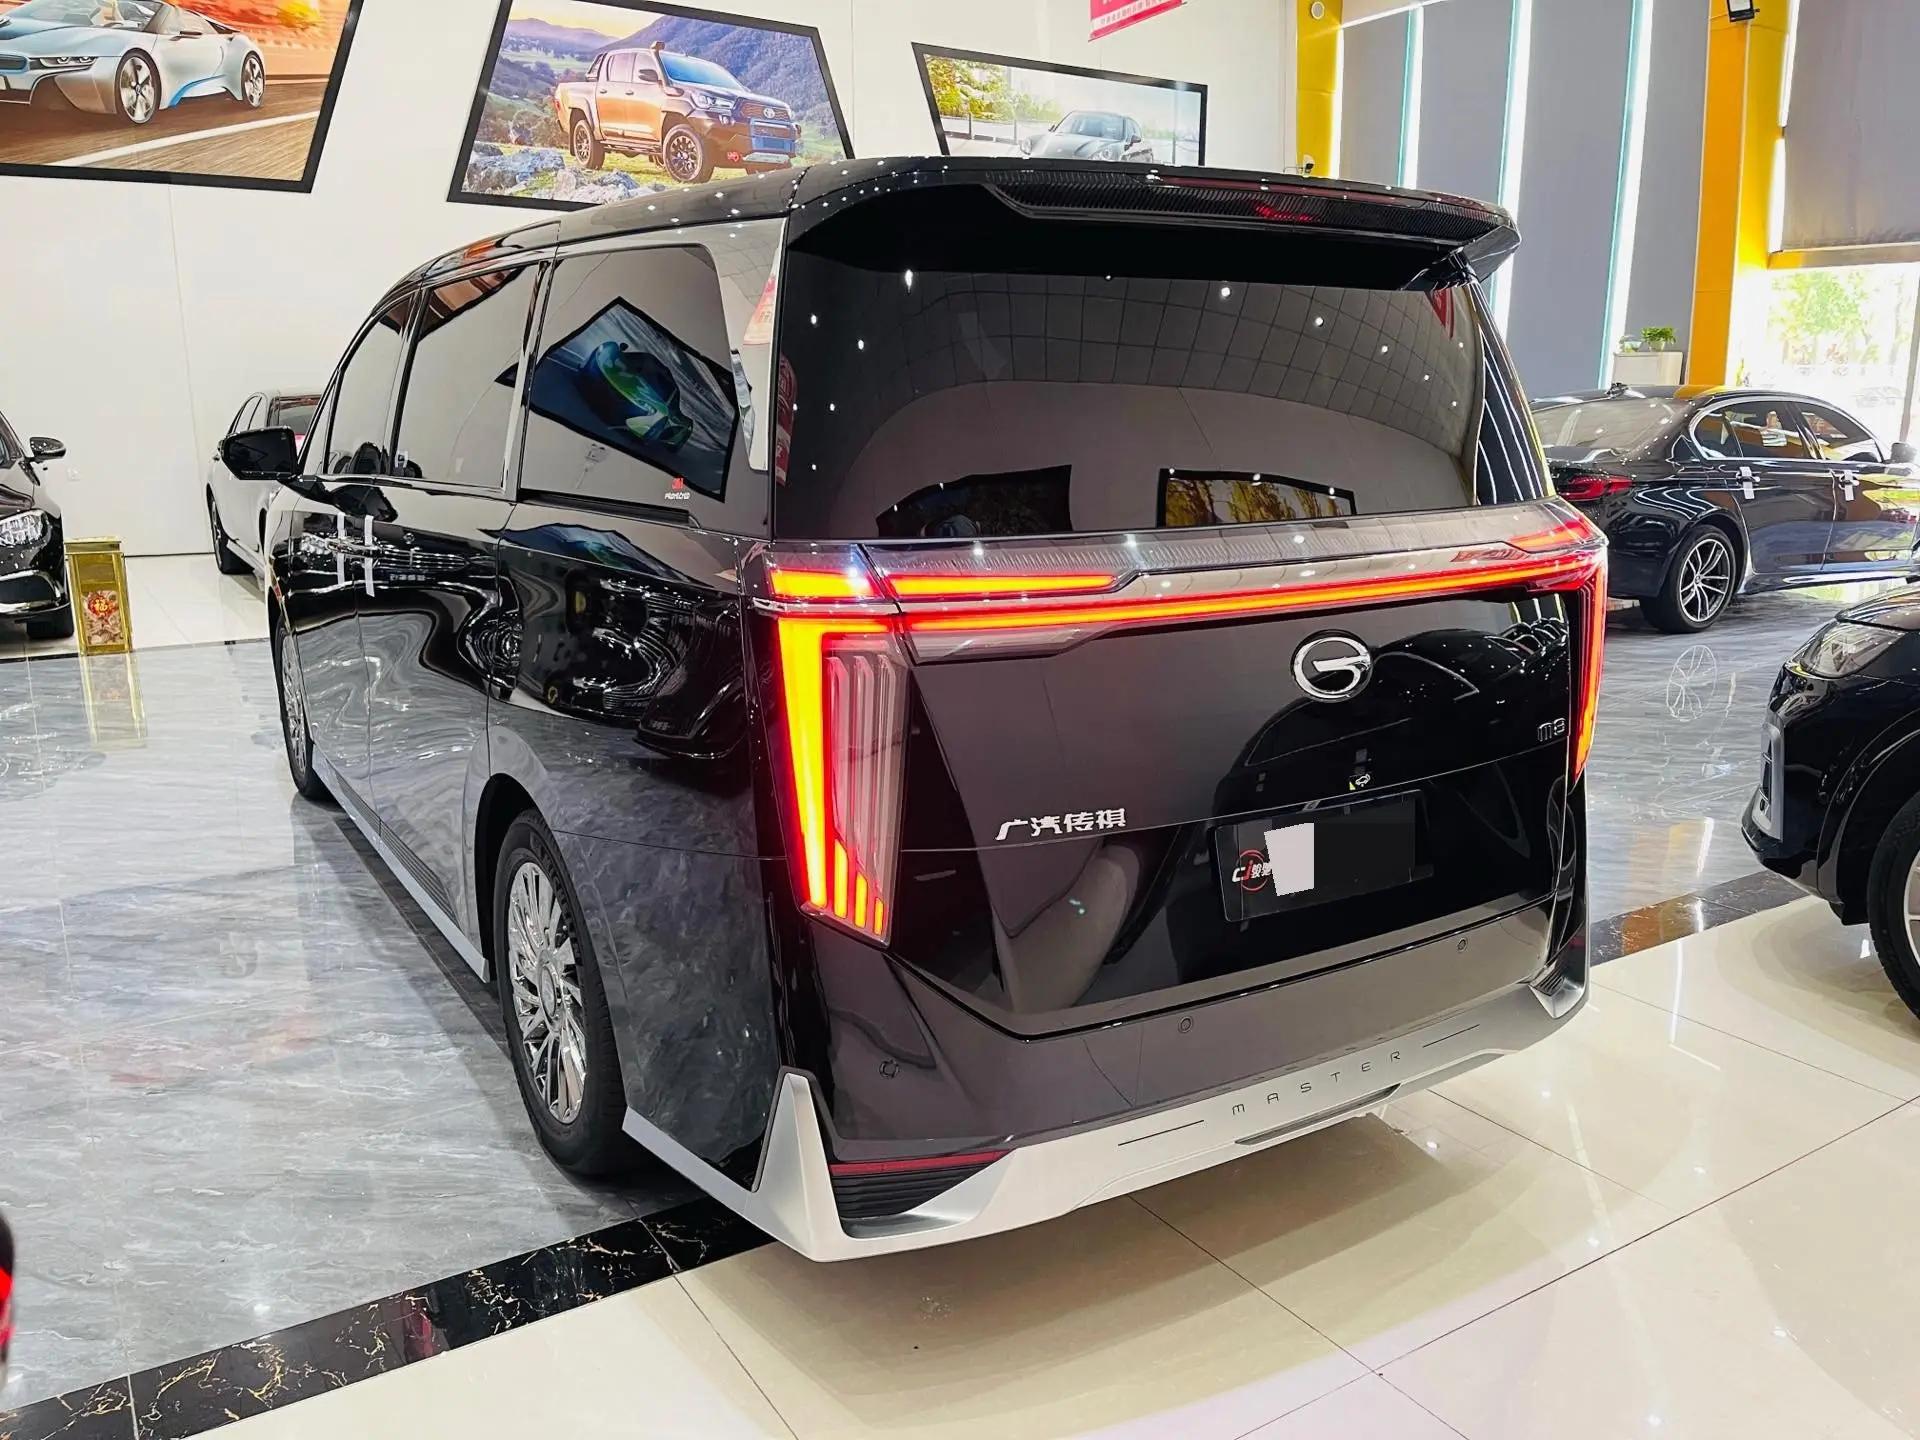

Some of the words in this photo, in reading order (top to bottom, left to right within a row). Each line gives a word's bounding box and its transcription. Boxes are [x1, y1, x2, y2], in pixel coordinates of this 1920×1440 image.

[995, 807, 1126, 841] 广汽传祺
[1231, 1051, 1401, 1116] MASTER
